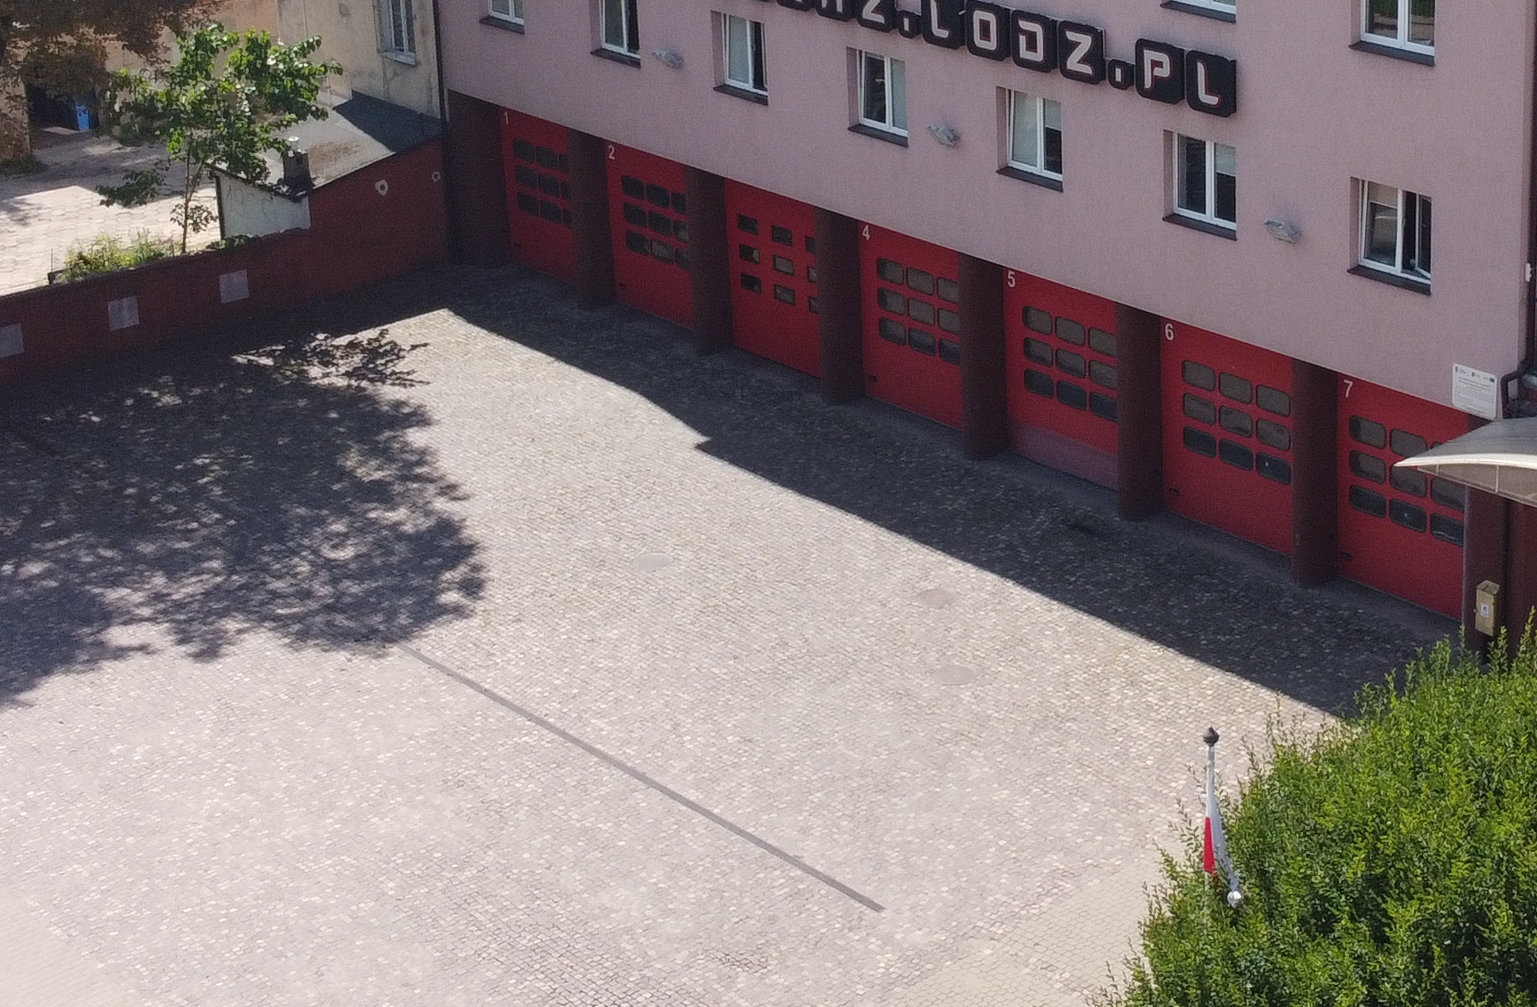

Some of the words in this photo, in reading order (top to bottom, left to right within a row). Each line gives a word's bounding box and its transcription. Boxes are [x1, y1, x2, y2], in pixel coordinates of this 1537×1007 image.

[607, 144, 616, 161] 2
[861, 224, 871, 241] 4
[1006, 270, 1016, 288] 5
[1164, 322, 1175, 341] 6
[1343, 379, 1354, 398] 7
